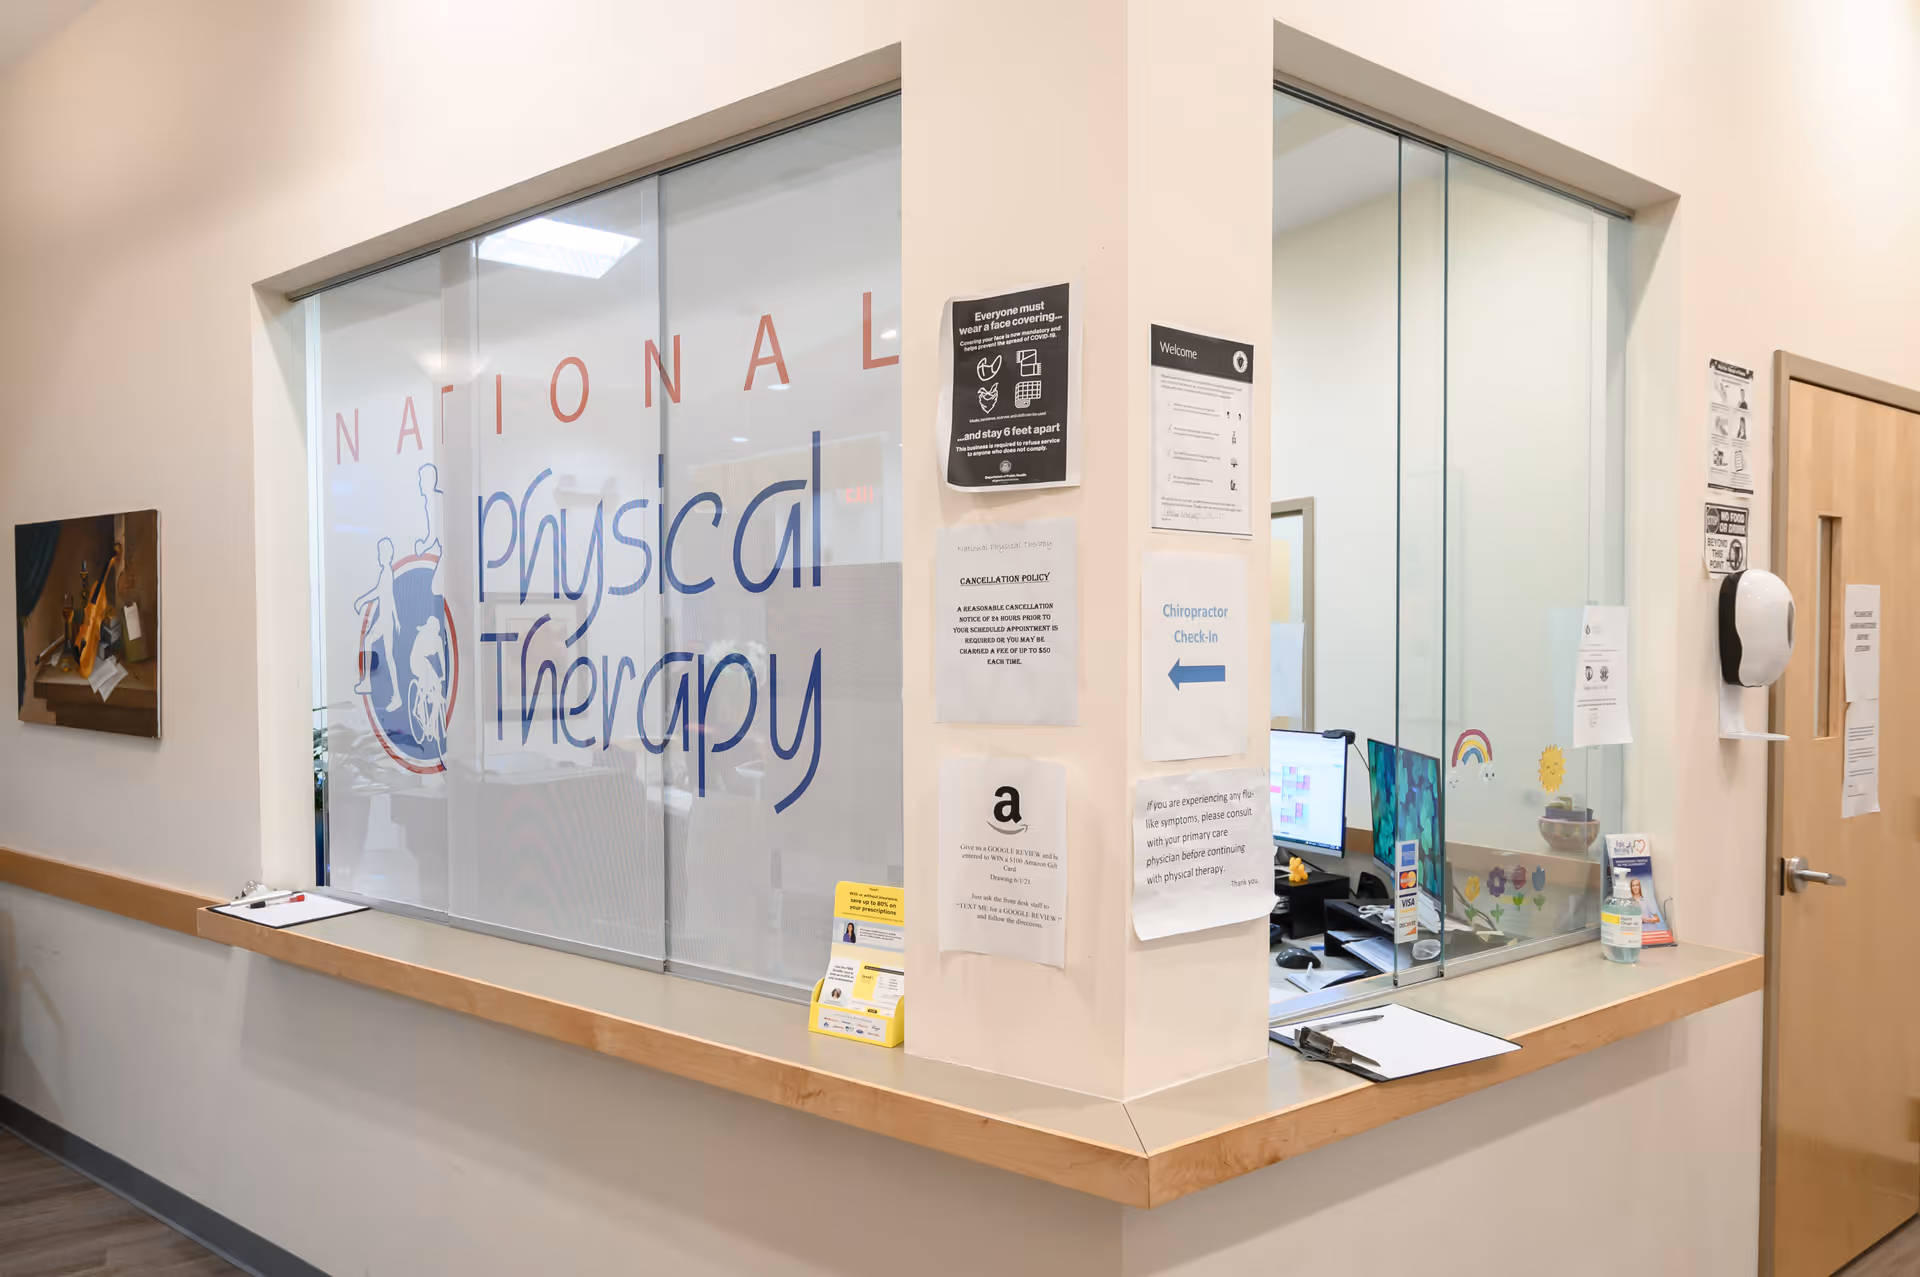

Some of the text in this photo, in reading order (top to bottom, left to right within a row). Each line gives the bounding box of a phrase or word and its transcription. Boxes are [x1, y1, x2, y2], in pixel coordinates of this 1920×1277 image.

[975, 301, 1044, 321] Everyone must
[959, 312, 1062, 335] wear a face covering...
[1022, 327, 1049, 335] mandatory
[1006, 337, 1023, 345] spread
[1030, 332, 1057, 340] COVID-19.
[1159, 341, 1197, 360] Welcome
[957, 423, 1060, 442] ...and stay 6 feet apart
[1721, 512, 1744, 523] NO FOOD
[1720, 522, 1728, 532] OR
[1707, 538, 1727, 547] BEYOND
[1712, 549, 1723, 558] THIS
[1710, 560, 1724, 569] POINT
[960, 572, 1050, 584] CANCELLATION POLICY
[1163, 604, 1228, 620] Chiropractor
[1174, 629, 1218, 643] Check-In
[479, 614, 822, 813] Therapy
[994, 786, 1022, 823] a
[1147, 789, 1254, 811] If you are experiencing any flu-
[1145, 807, 1252, 829] like symptoms, please consult
[1147, 828, 1228, 847] with your primary care
[988, 846, 1014, 854] GOOGLE
[1016, 849, 1040, 857] REVIEW
[1146, 844, 1245, 868] physician before continuing
[990, 874, 1013, 883] Drawing
[1147, 864, 1226, 884] with physical therapy.
[1401, 898, 1415, 908] VISA
[862, 907, 896, 915] prescriptions
[1003, 908, 1029, 917] GOOGLE
